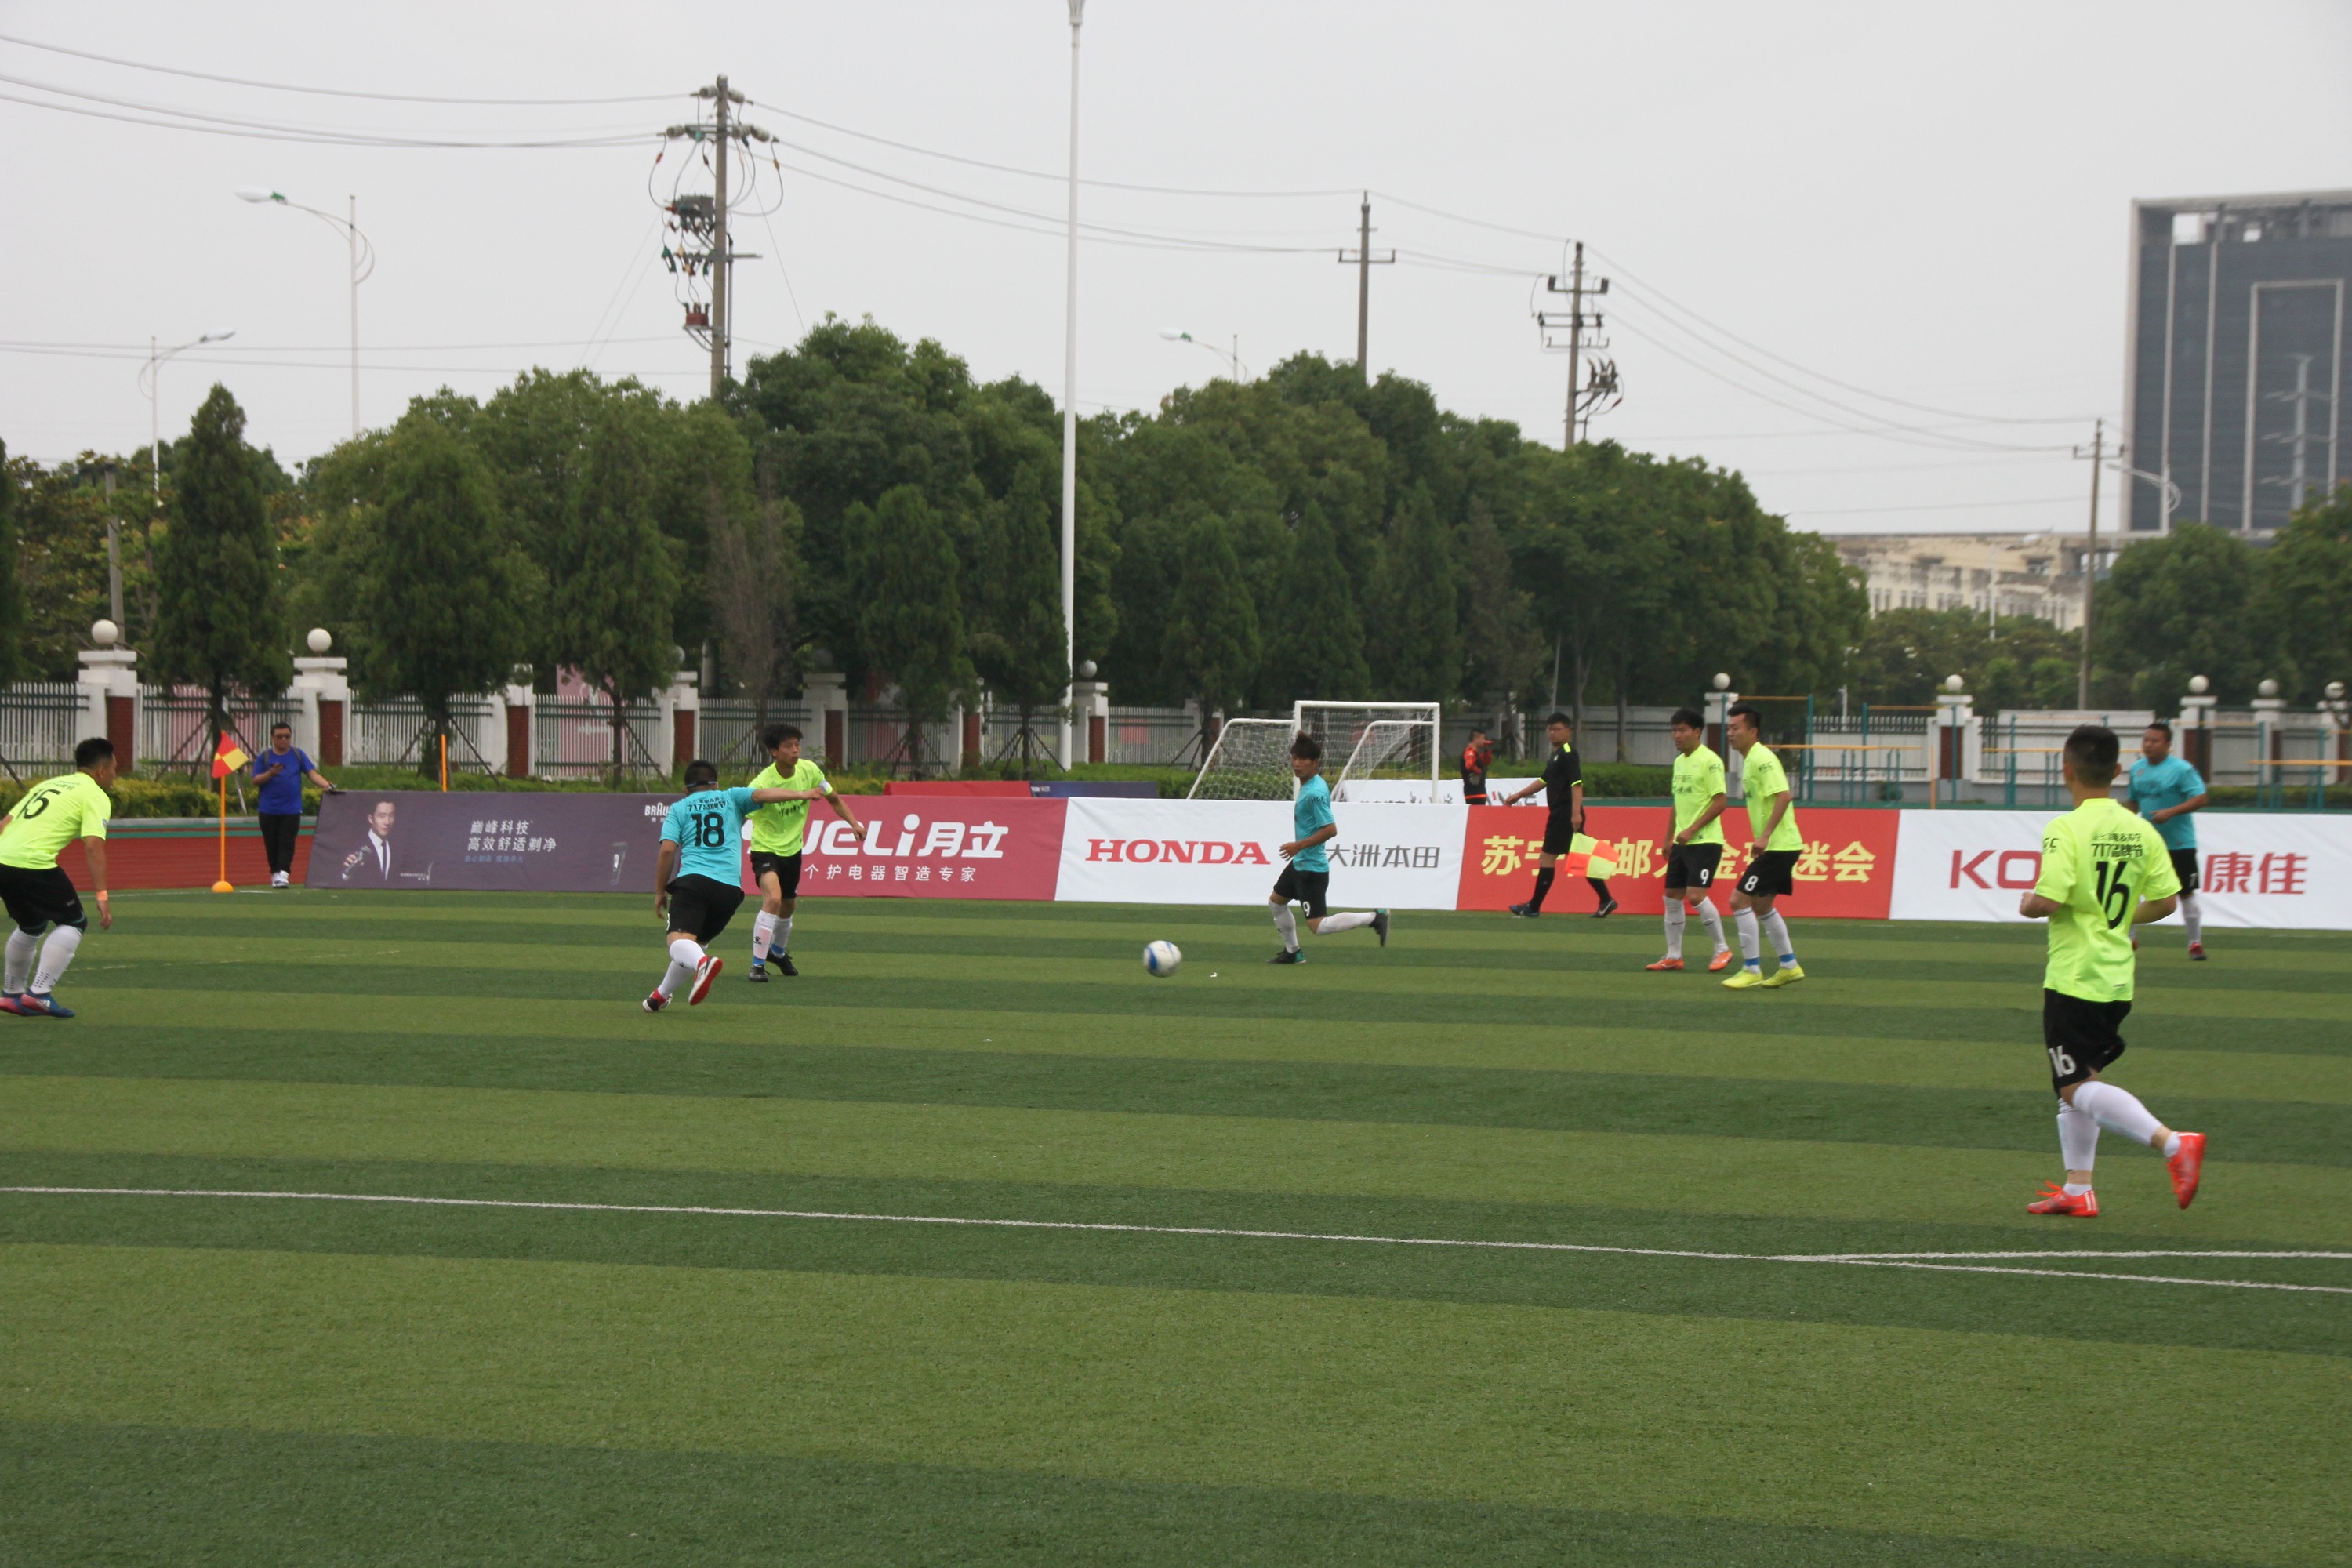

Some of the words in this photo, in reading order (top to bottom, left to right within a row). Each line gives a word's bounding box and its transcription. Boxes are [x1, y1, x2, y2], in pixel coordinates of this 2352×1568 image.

[16, 789, 61, 820] 15
[644, 802, 670, 816] BRAU
[470, 819, 530, 835] 巅峰科技
[691, 811, 724, 848] 18
[916, 820, 1009, 858] 月立
[467, 836, 557, 852] 高效舒适剃净
[1085, 838, 1272, 865] HONDA
[1326, 844, 1440, 868] 大洲本田
[804, 864, 976, 883] 个护电器智造专家
[1700, 869, 1709, 885] 9
[1744, 875, 1759, 891] 8
[2202, 851, 2309, 895] 康佳
[2095, 860, 2130, 930] 16
[1303, 900, 1312, 916] 9
[2049, 1045, 2077, 1077] 16
